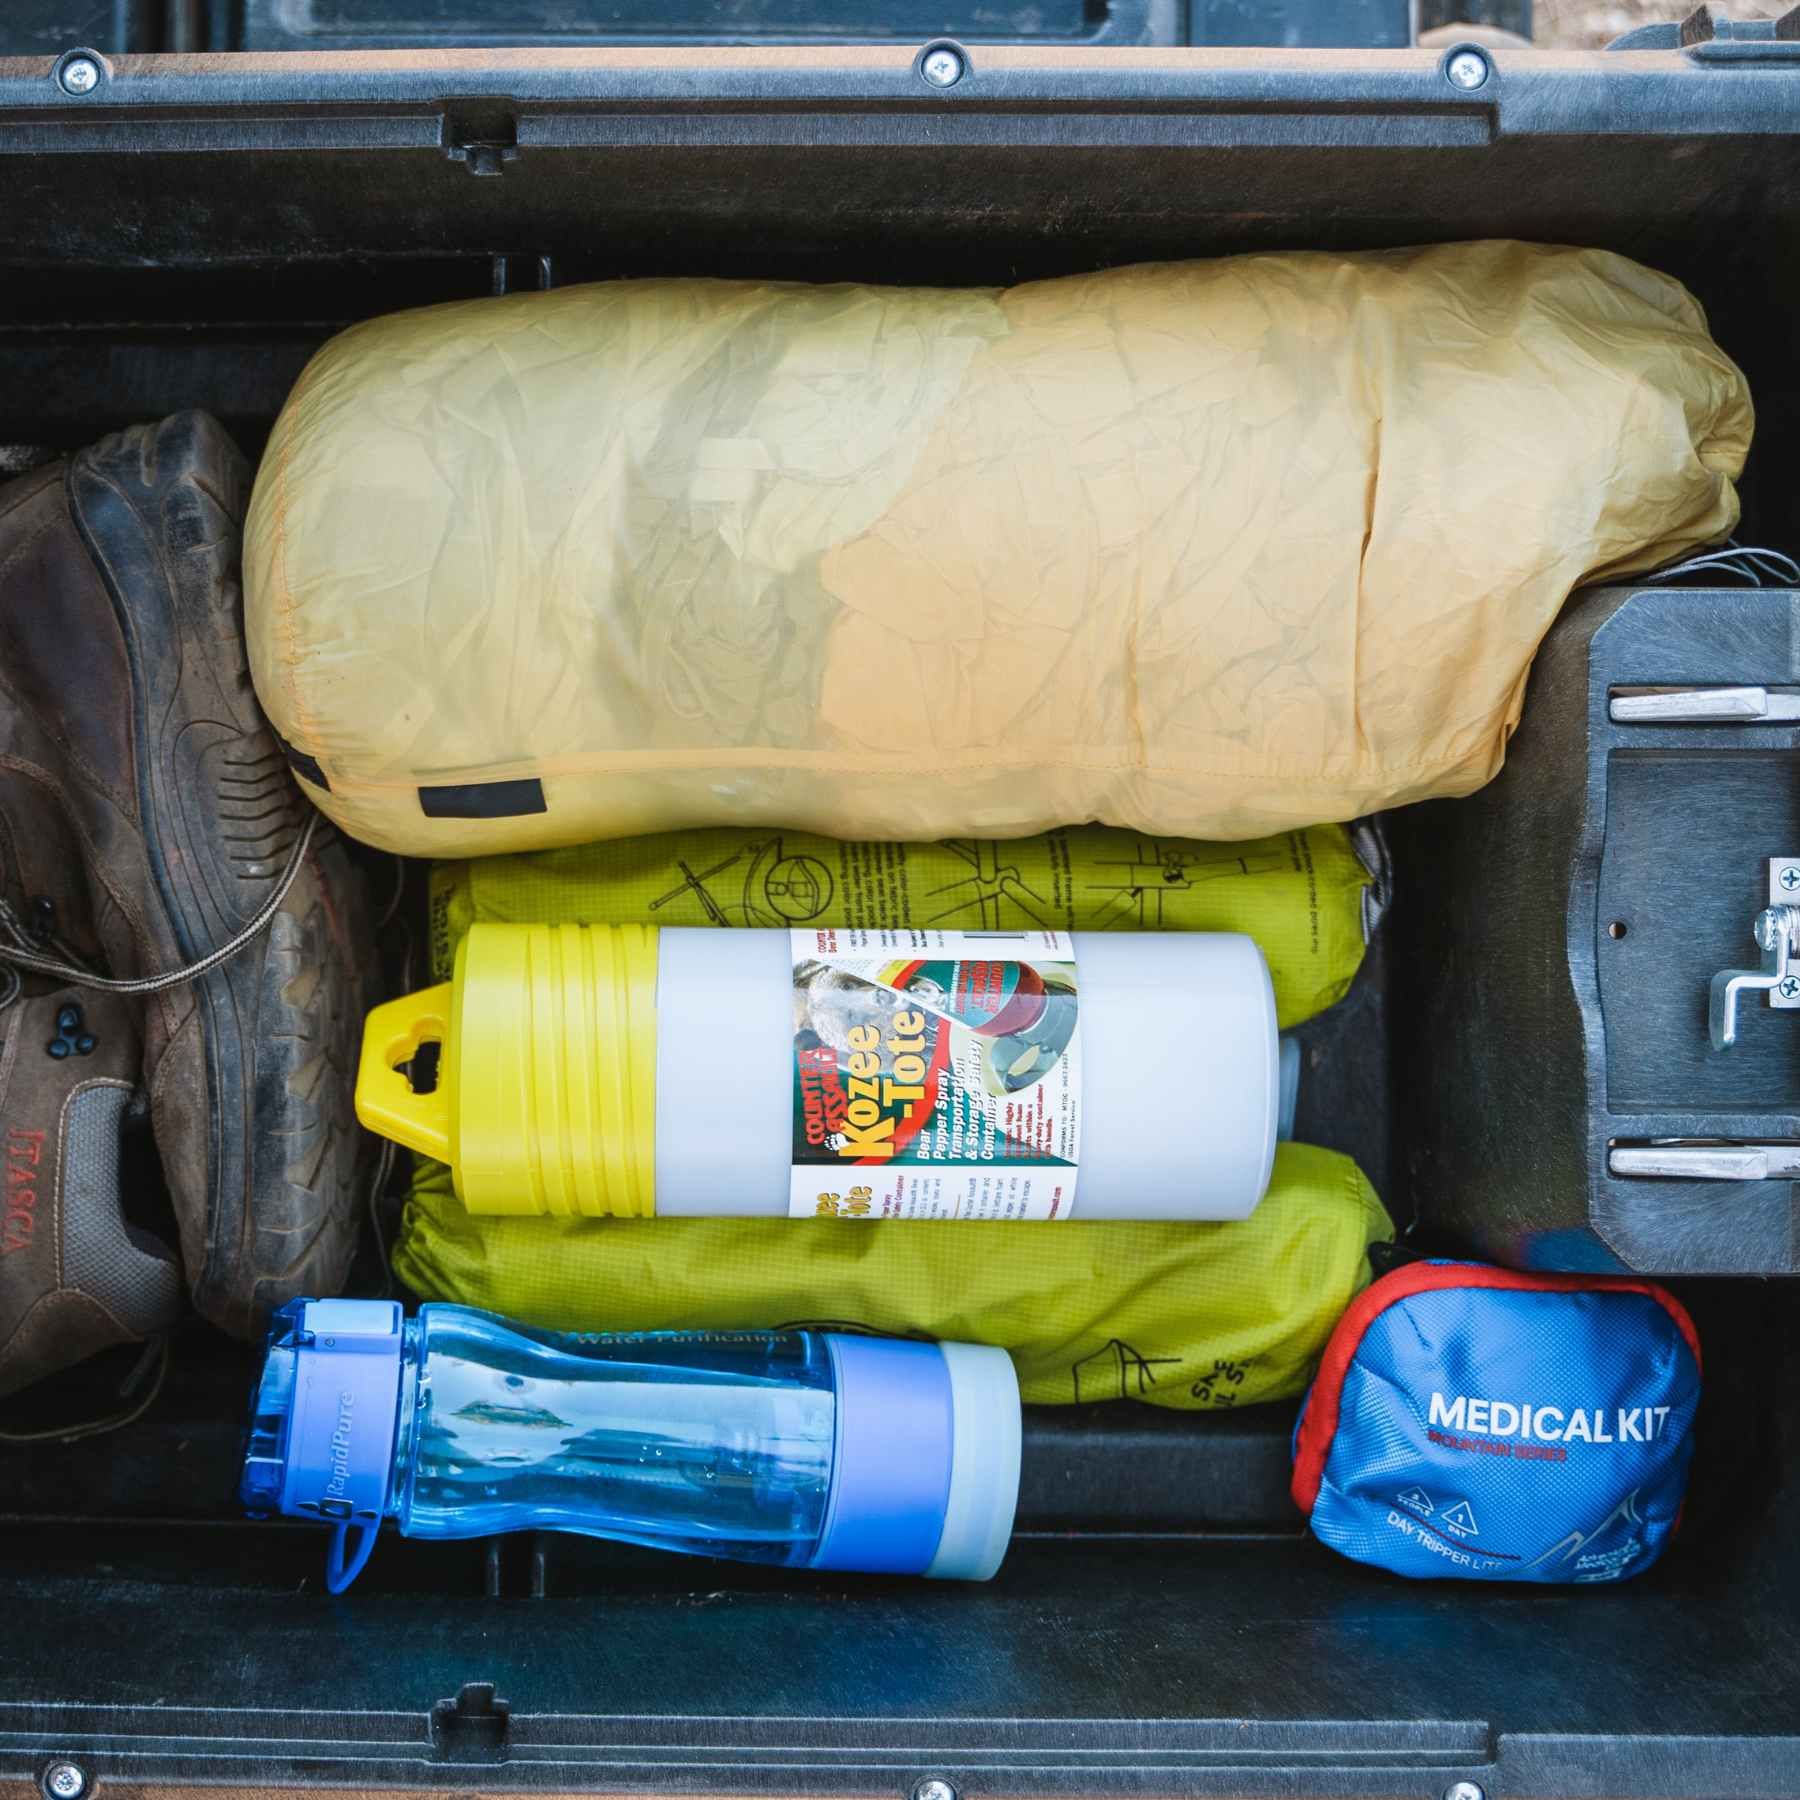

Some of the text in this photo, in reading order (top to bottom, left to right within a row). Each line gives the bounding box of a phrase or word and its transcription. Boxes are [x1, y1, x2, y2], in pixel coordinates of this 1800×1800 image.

[798, 1047, 826, 1144] COUNTER
[837, 1025, 896, 1157] Kozee
[883, 1011, 926, 1119] -Tote
[934, 1068, 950, 1160] Pepper Spray
[948, 1058, 967, 1160] Transportation
[967, 1092, 984, 1146] Storage
[982, 1093, 997, 1160] Container
[917, 1129, 932, 1160] Bear
[967, 1148, 979, 1160] &
[0, 1129, 44, 1255] ITASCA
[326, 1392, 354, 1496] RapidPure
[1428, 1392, 1671, 1443] MEDICAL KIT
[1428, 1431, 1567, 1462] MOUNTAIN SERIES
[1387, 1511, 1415, 1535] DAY
[1416, 1530, 1471, 1567] TRIPPER
[1448, 1525, 1466, 1538] DAY
